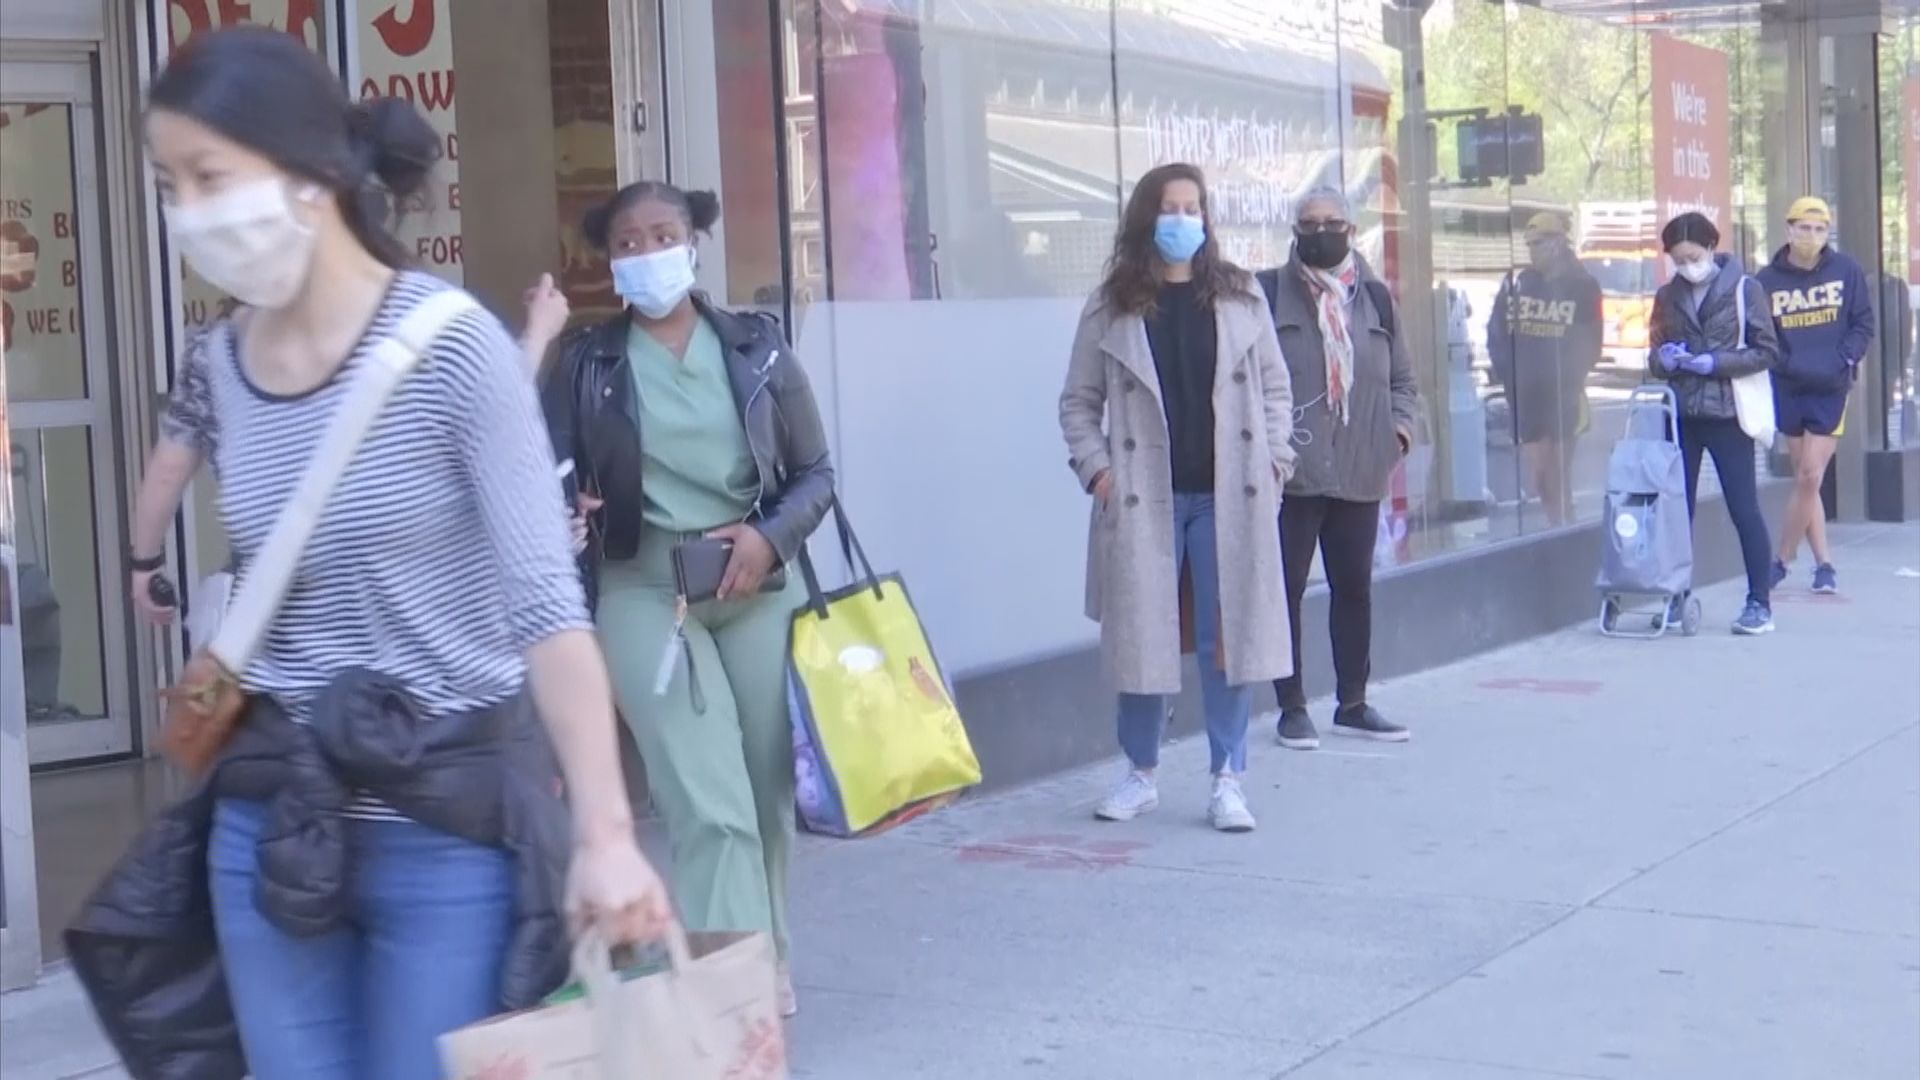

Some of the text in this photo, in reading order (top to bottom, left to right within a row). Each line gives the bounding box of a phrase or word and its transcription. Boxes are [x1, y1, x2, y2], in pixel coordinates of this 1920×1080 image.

[1671, 81, 1707, 126] We're
[1672, 136, 1711, 181] in this
[1772, 280, 1844, 316] PACE
[26, 307, 62, 335] WE
[1781, 307, 1838, 329] UNIVERSITY
